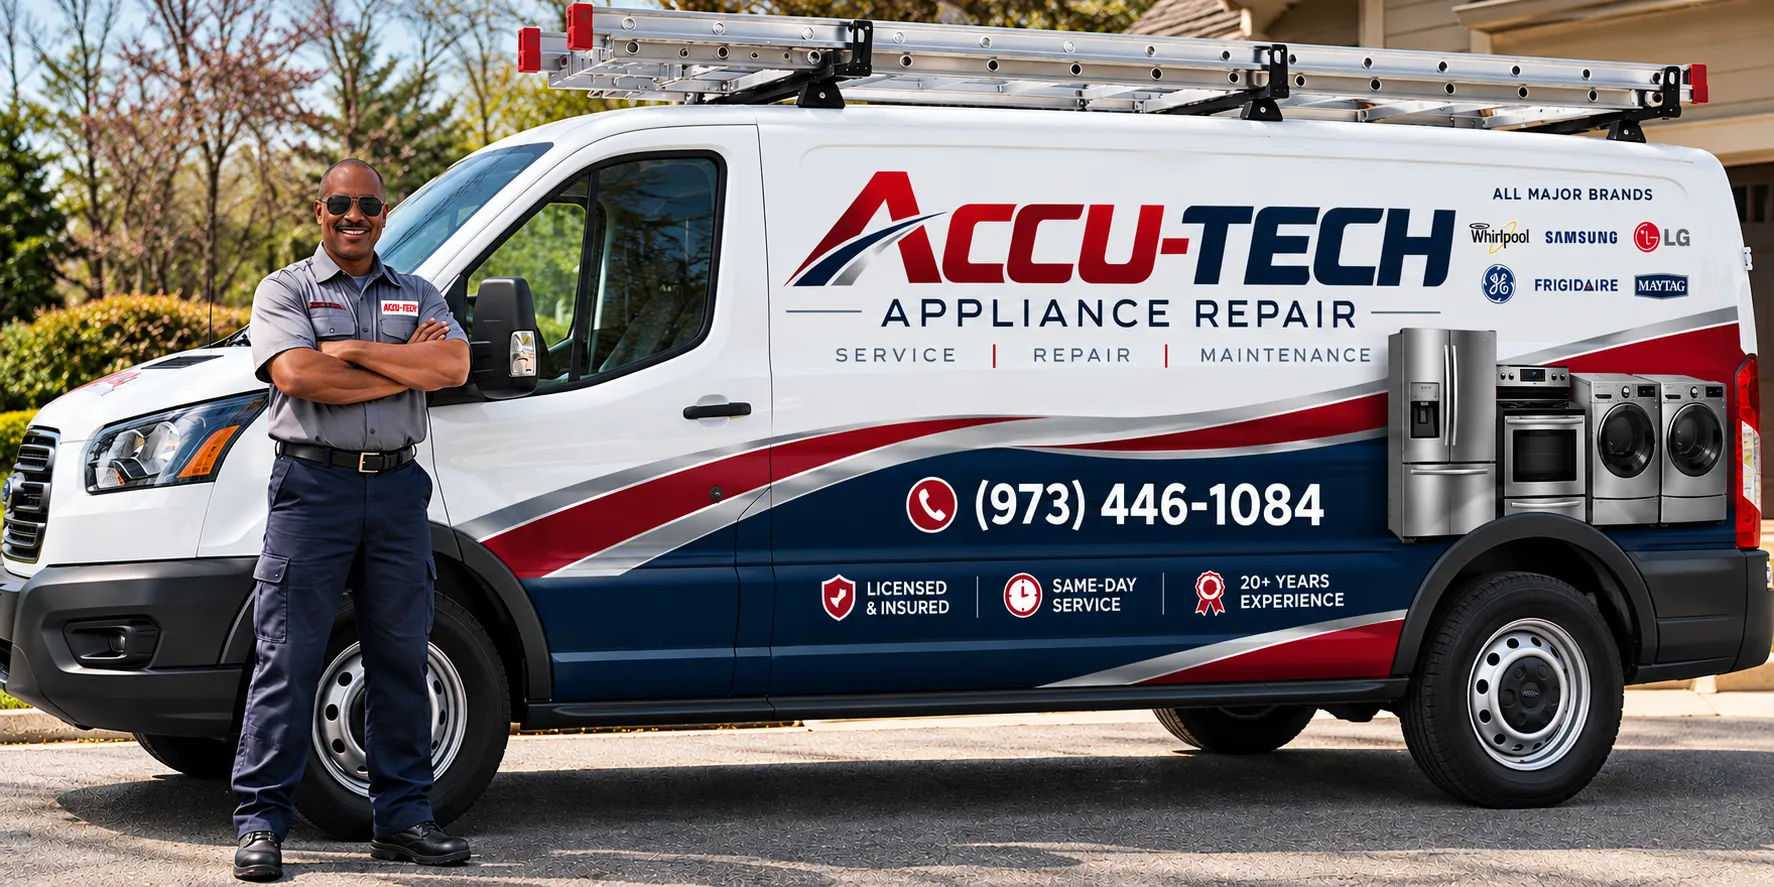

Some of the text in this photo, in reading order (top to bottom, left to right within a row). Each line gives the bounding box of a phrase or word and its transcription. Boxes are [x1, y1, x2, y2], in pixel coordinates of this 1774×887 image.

[1492, 187, 1653, 201] ALL MAJOR BRANDS
[783, 171, 1457, 287] ACCU-TECH
[1470, 228, 1530, 249] Whirlpool
[1545, 230, 1618, 245] SAMSUNG
[1664, 228, 1691, 247] LG
[1534, 278, 1619, 292] FRIGIDAIRE
[1638, 279, 1686, 292] MAYTAG
[880, 298, 1356, 329] APPLIANCE REPAIR
[835, 347, 956, 363] SERVICE
[1033, 347, 1130, 363] REPAIR
[1200, 347, 1372, 363] MAINTENANCE
[975, 479, 1325, 531] (973) 446-1084
[867, 580, 948, 596] LICENSED
[1052, 577, 1138, 594] SAME-DAY
[1240, 574, 1330, 590] 20+ YEARS
[866, 600, 950, 616] & INSURED
[1052, 597, 1122, 613] SERVICE
[1240, 592, 1345, 610] EXPERIENCE
